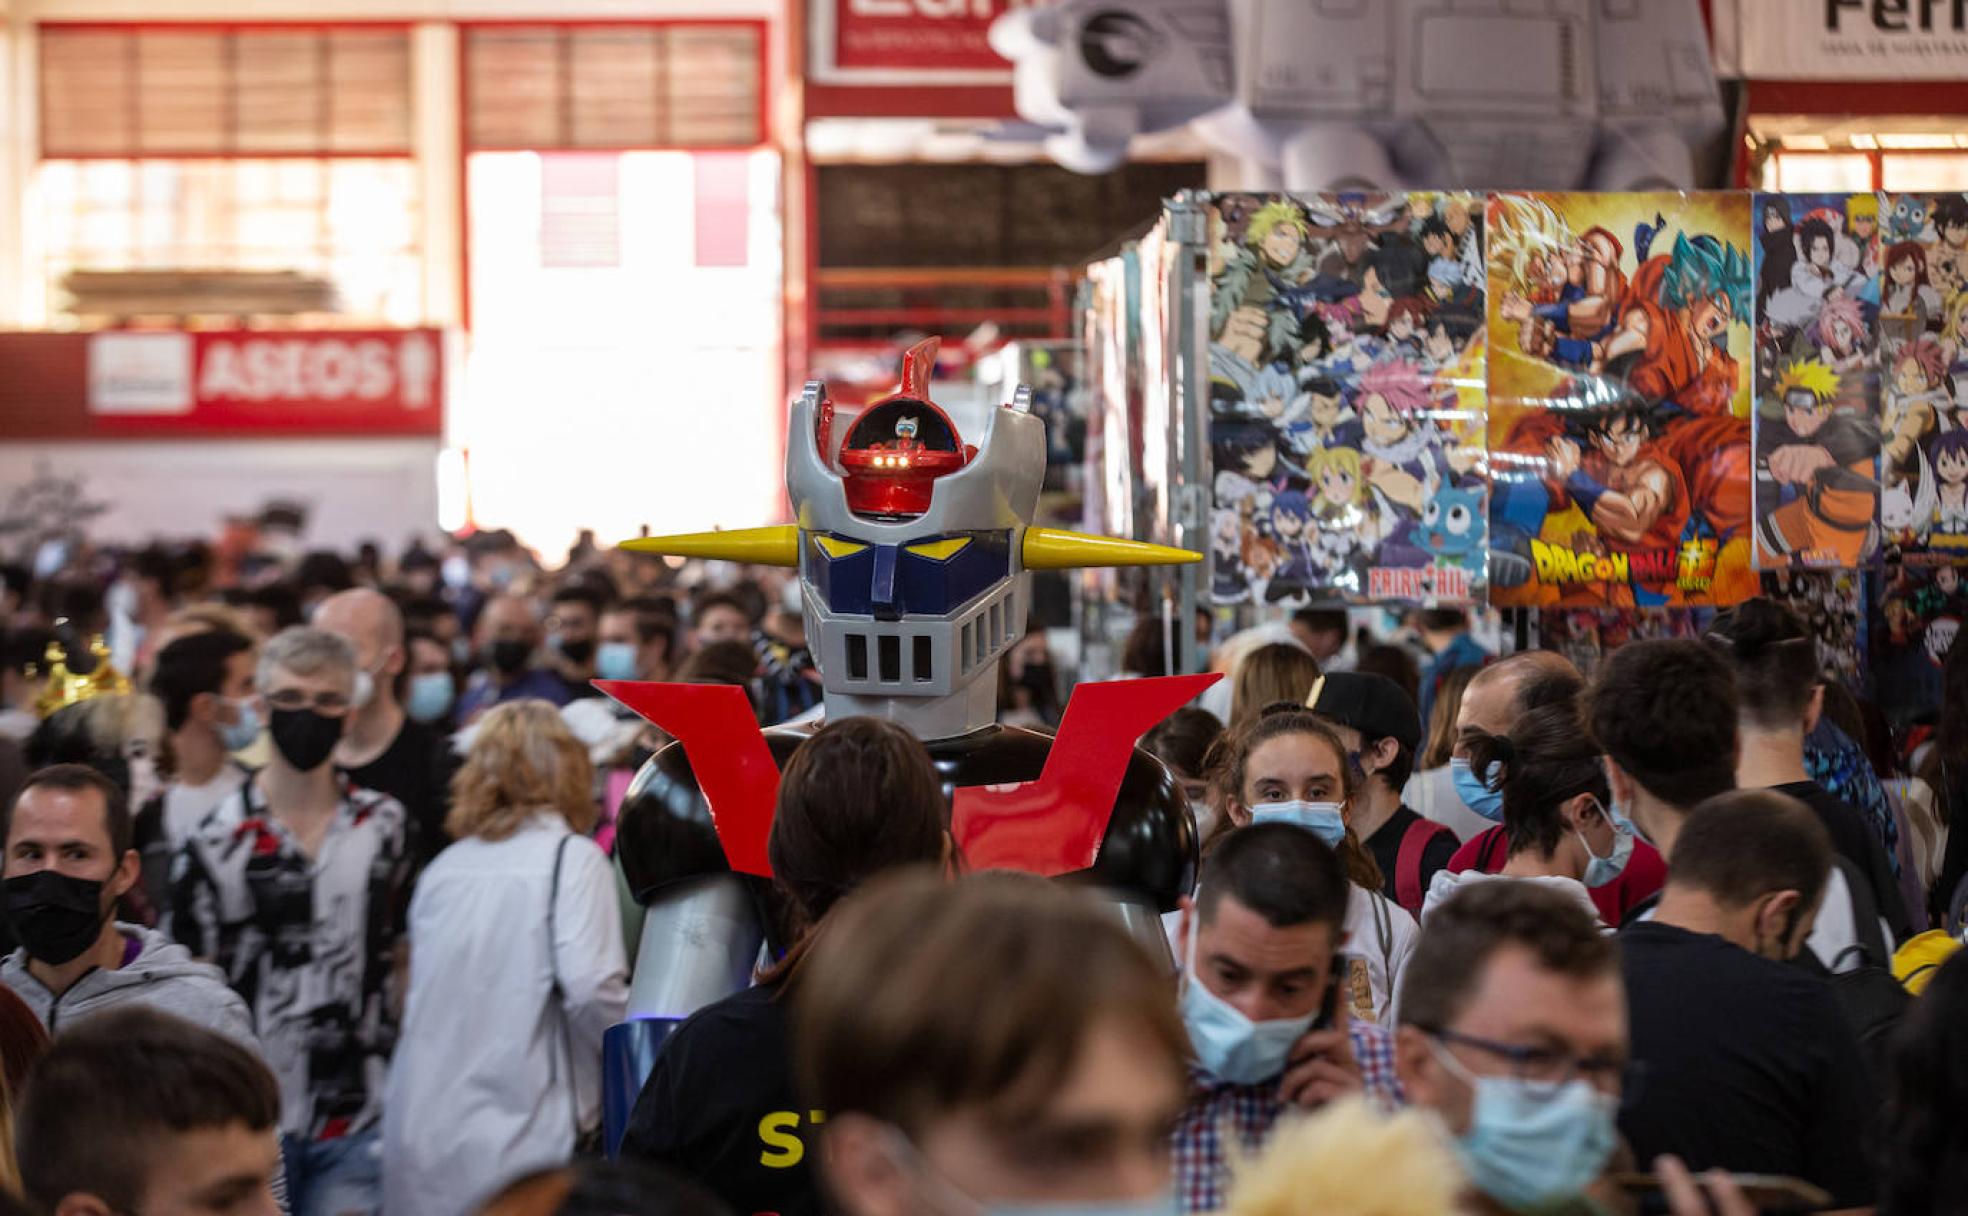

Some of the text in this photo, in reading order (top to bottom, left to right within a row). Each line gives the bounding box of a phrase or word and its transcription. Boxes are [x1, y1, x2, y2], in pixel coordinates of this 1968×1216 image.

[200, 339, 395, 400] ASEOS
[1369, 567, 1422, 598] FAIRY
[1530, 537, 1677, 585] DRAGON BALL
